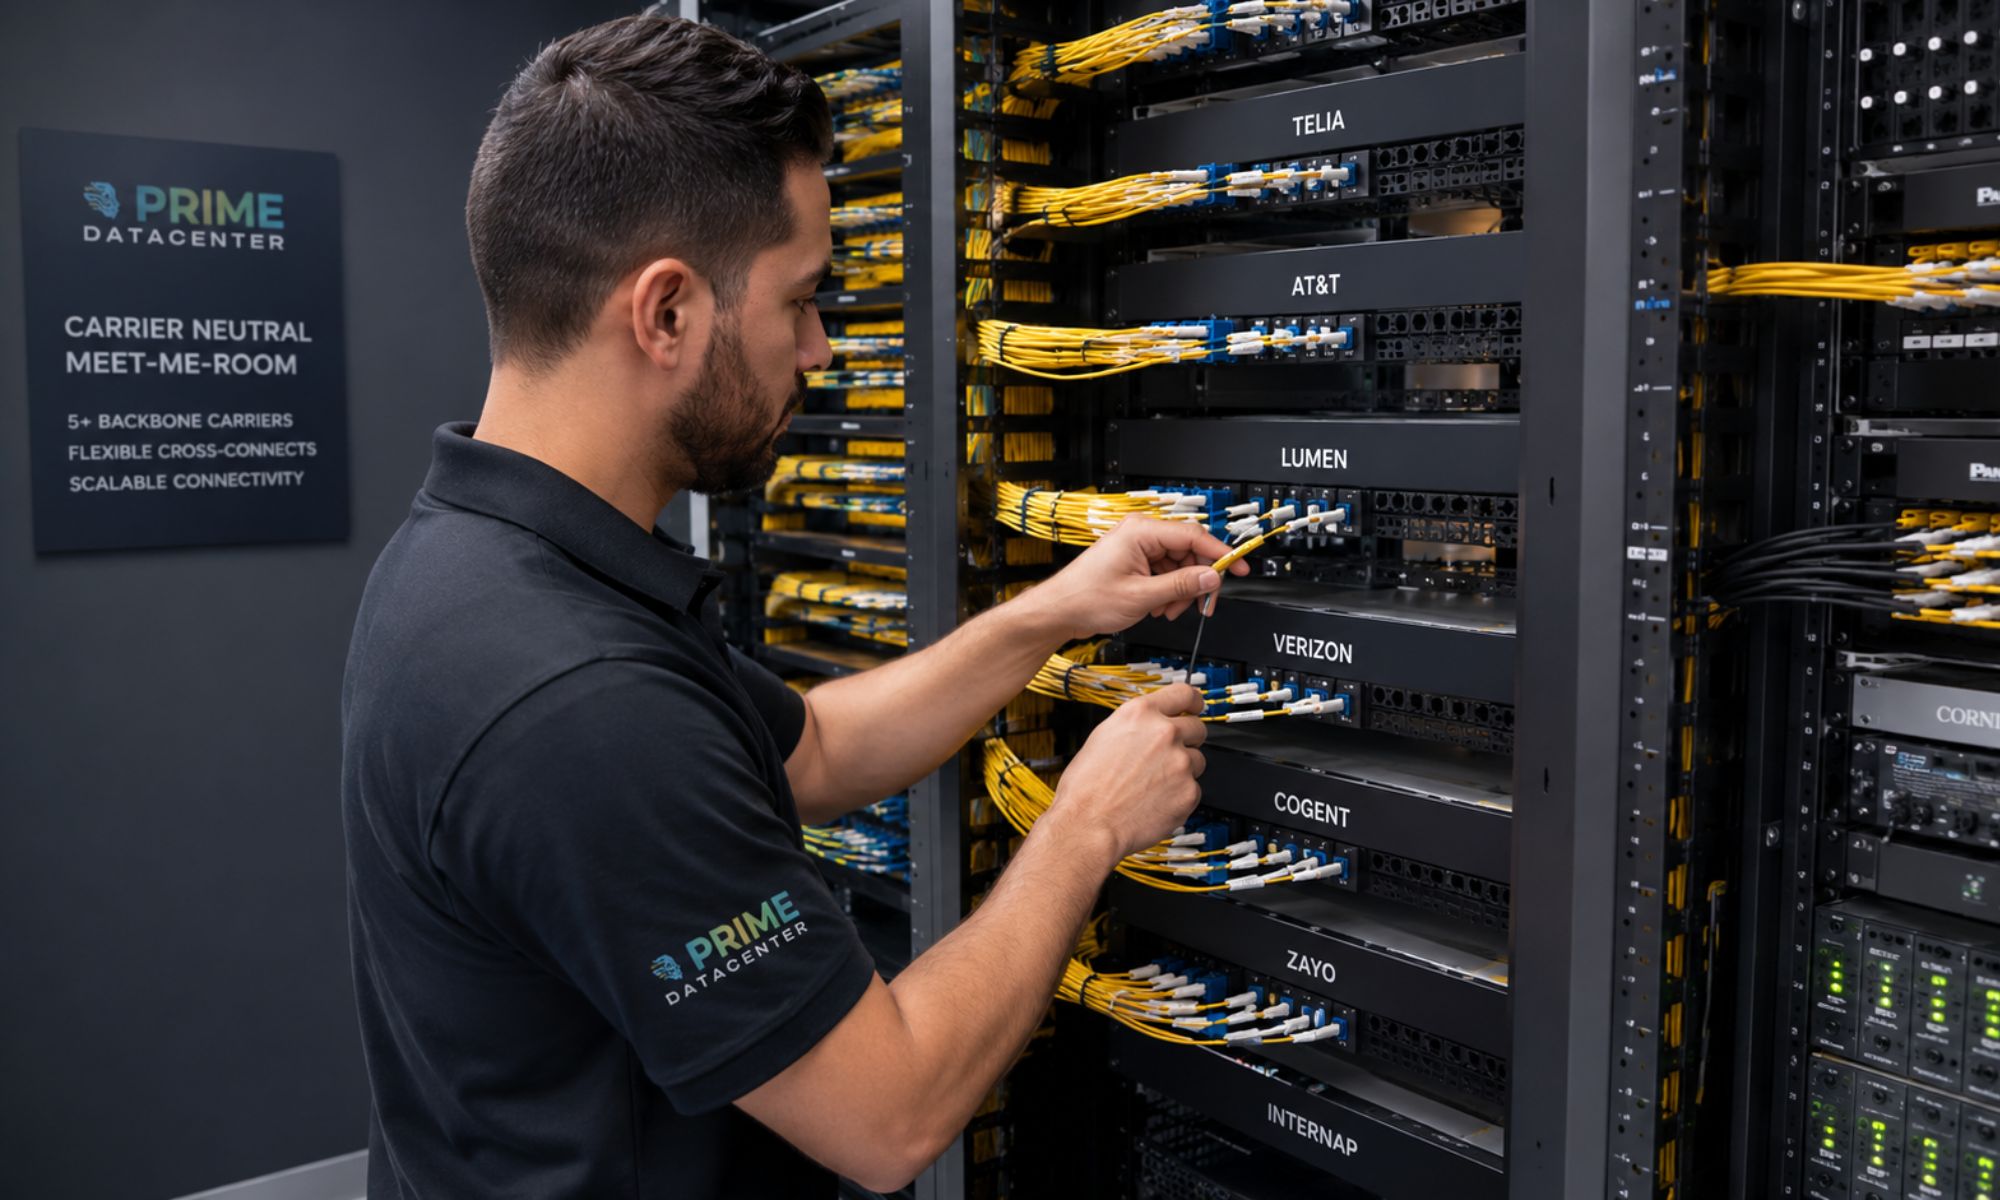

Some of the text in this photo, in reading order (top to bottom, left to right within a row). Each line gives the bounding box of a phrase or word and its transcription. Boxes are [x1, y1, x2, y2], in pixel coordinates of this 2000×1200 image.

[1292, 109, 1345, 137] TELIA
[136, 185, 285, 229] PRIME
[1977, 187, 2000, 206] PA
[83, 225, 285, 251] DATACENTER
[1291, 273, 1341, 297] AT&T
[64, 315, 313, 343] CARRIER NEUTRAL
[66, 351, 298, 375] MEET-ME-ROOM
[67, 412, 293, 430] 5+ BACKBONE CARRIERS
[68, 441, 317, 461] FLEXIBLE CROSS-CONNECTS
[1281, 447, 1348, 470] LUMEN
[69, 470, 304, 492] SCALABLE CONNECTIVITY
[1273, 632, 1353, 664] VERIZON
[1274, 791, 1351, 828] COGENT
[685, 890, 800, 971] PRIME
[665, 921, 808, 1006] DATACENTER
[1286, 949, 1337, 983] ZAYO
[1267, 1102, 1359, 1157] INTERNAP
